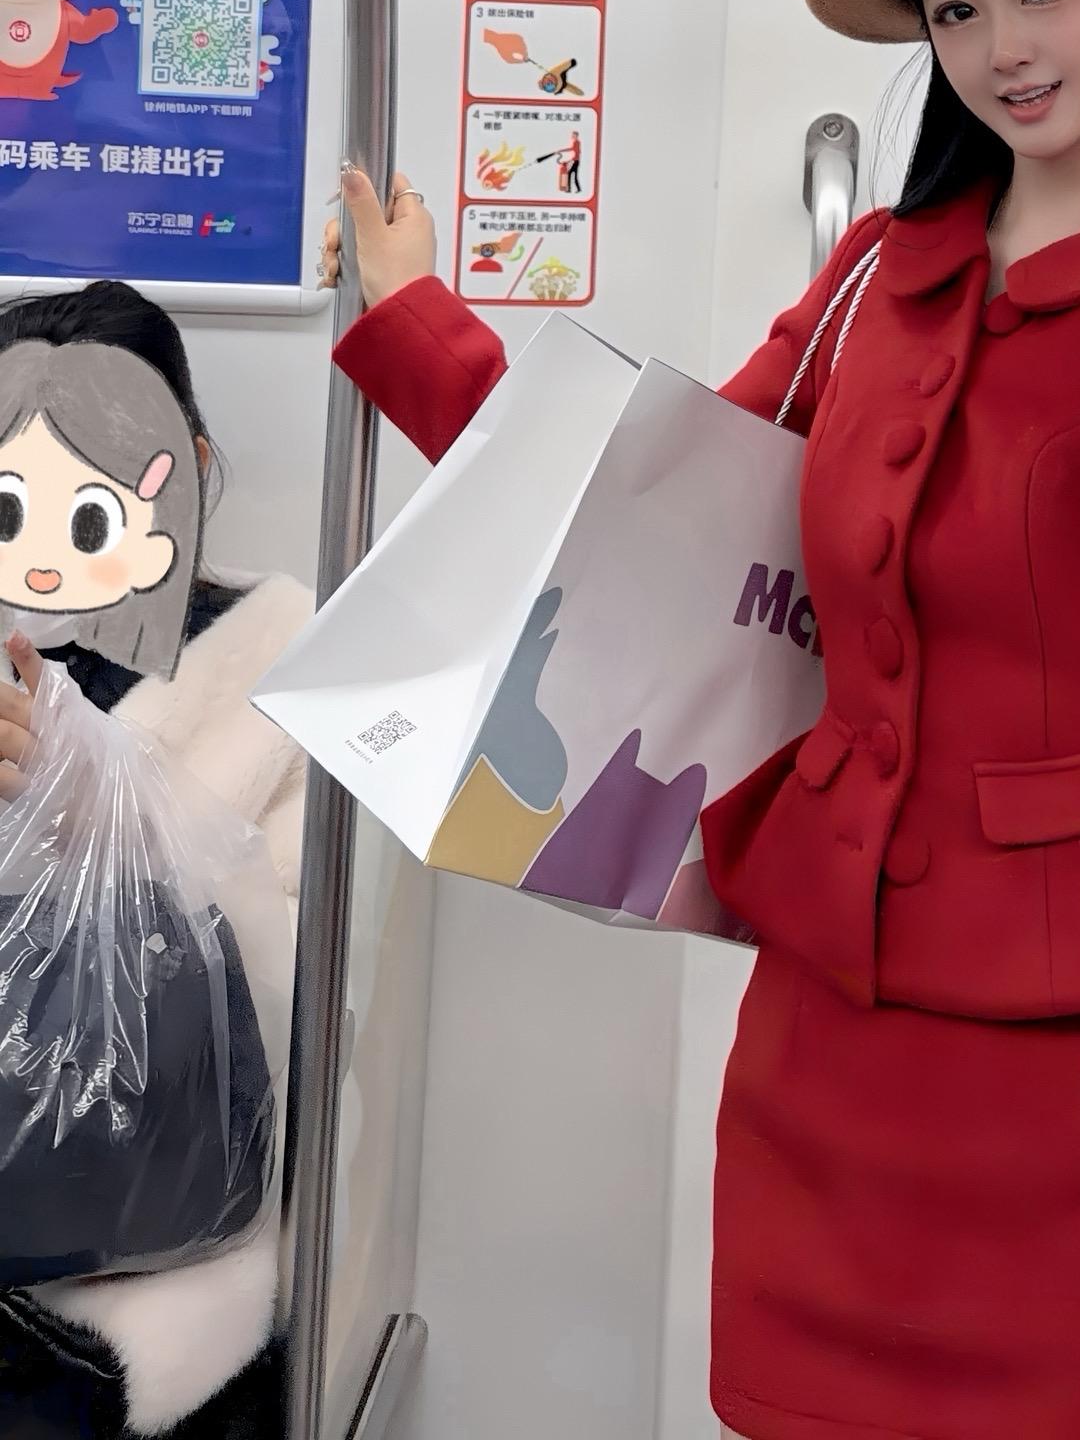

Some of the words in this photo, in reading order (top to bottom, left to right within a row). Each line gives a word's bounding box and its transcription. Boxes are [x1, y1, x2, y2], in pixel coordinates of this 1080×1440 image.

[476, 7, 484, 18] 3
[99, 143, 225, 177] 便捷出行
[127, 211, 194, 228] 苏宁金融
[468, 210, 476, 220] 5
